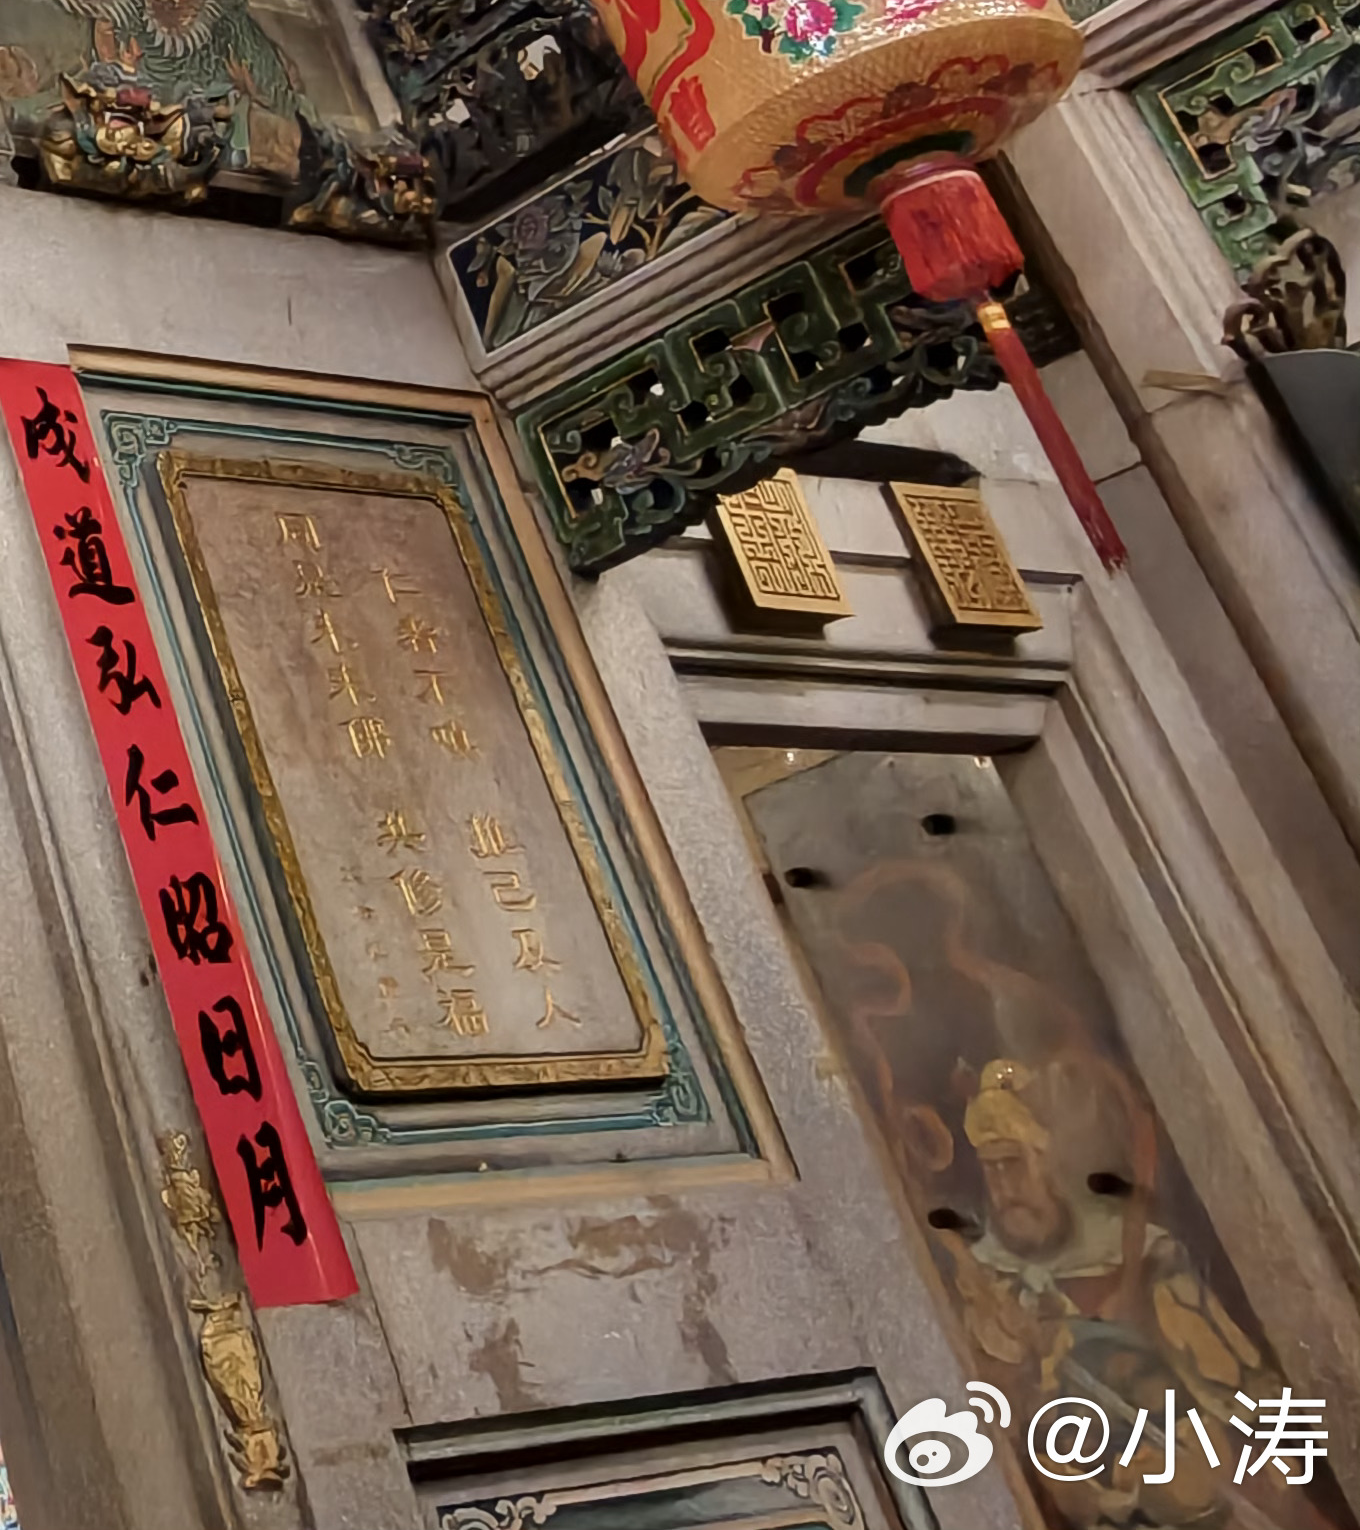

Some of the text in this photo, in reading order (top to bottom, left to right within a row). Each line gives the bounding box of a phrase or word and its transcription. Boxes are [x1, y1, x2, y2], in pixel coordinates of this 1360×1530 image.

[24, 388, 309, 1252] 成道弘仁昭日月
